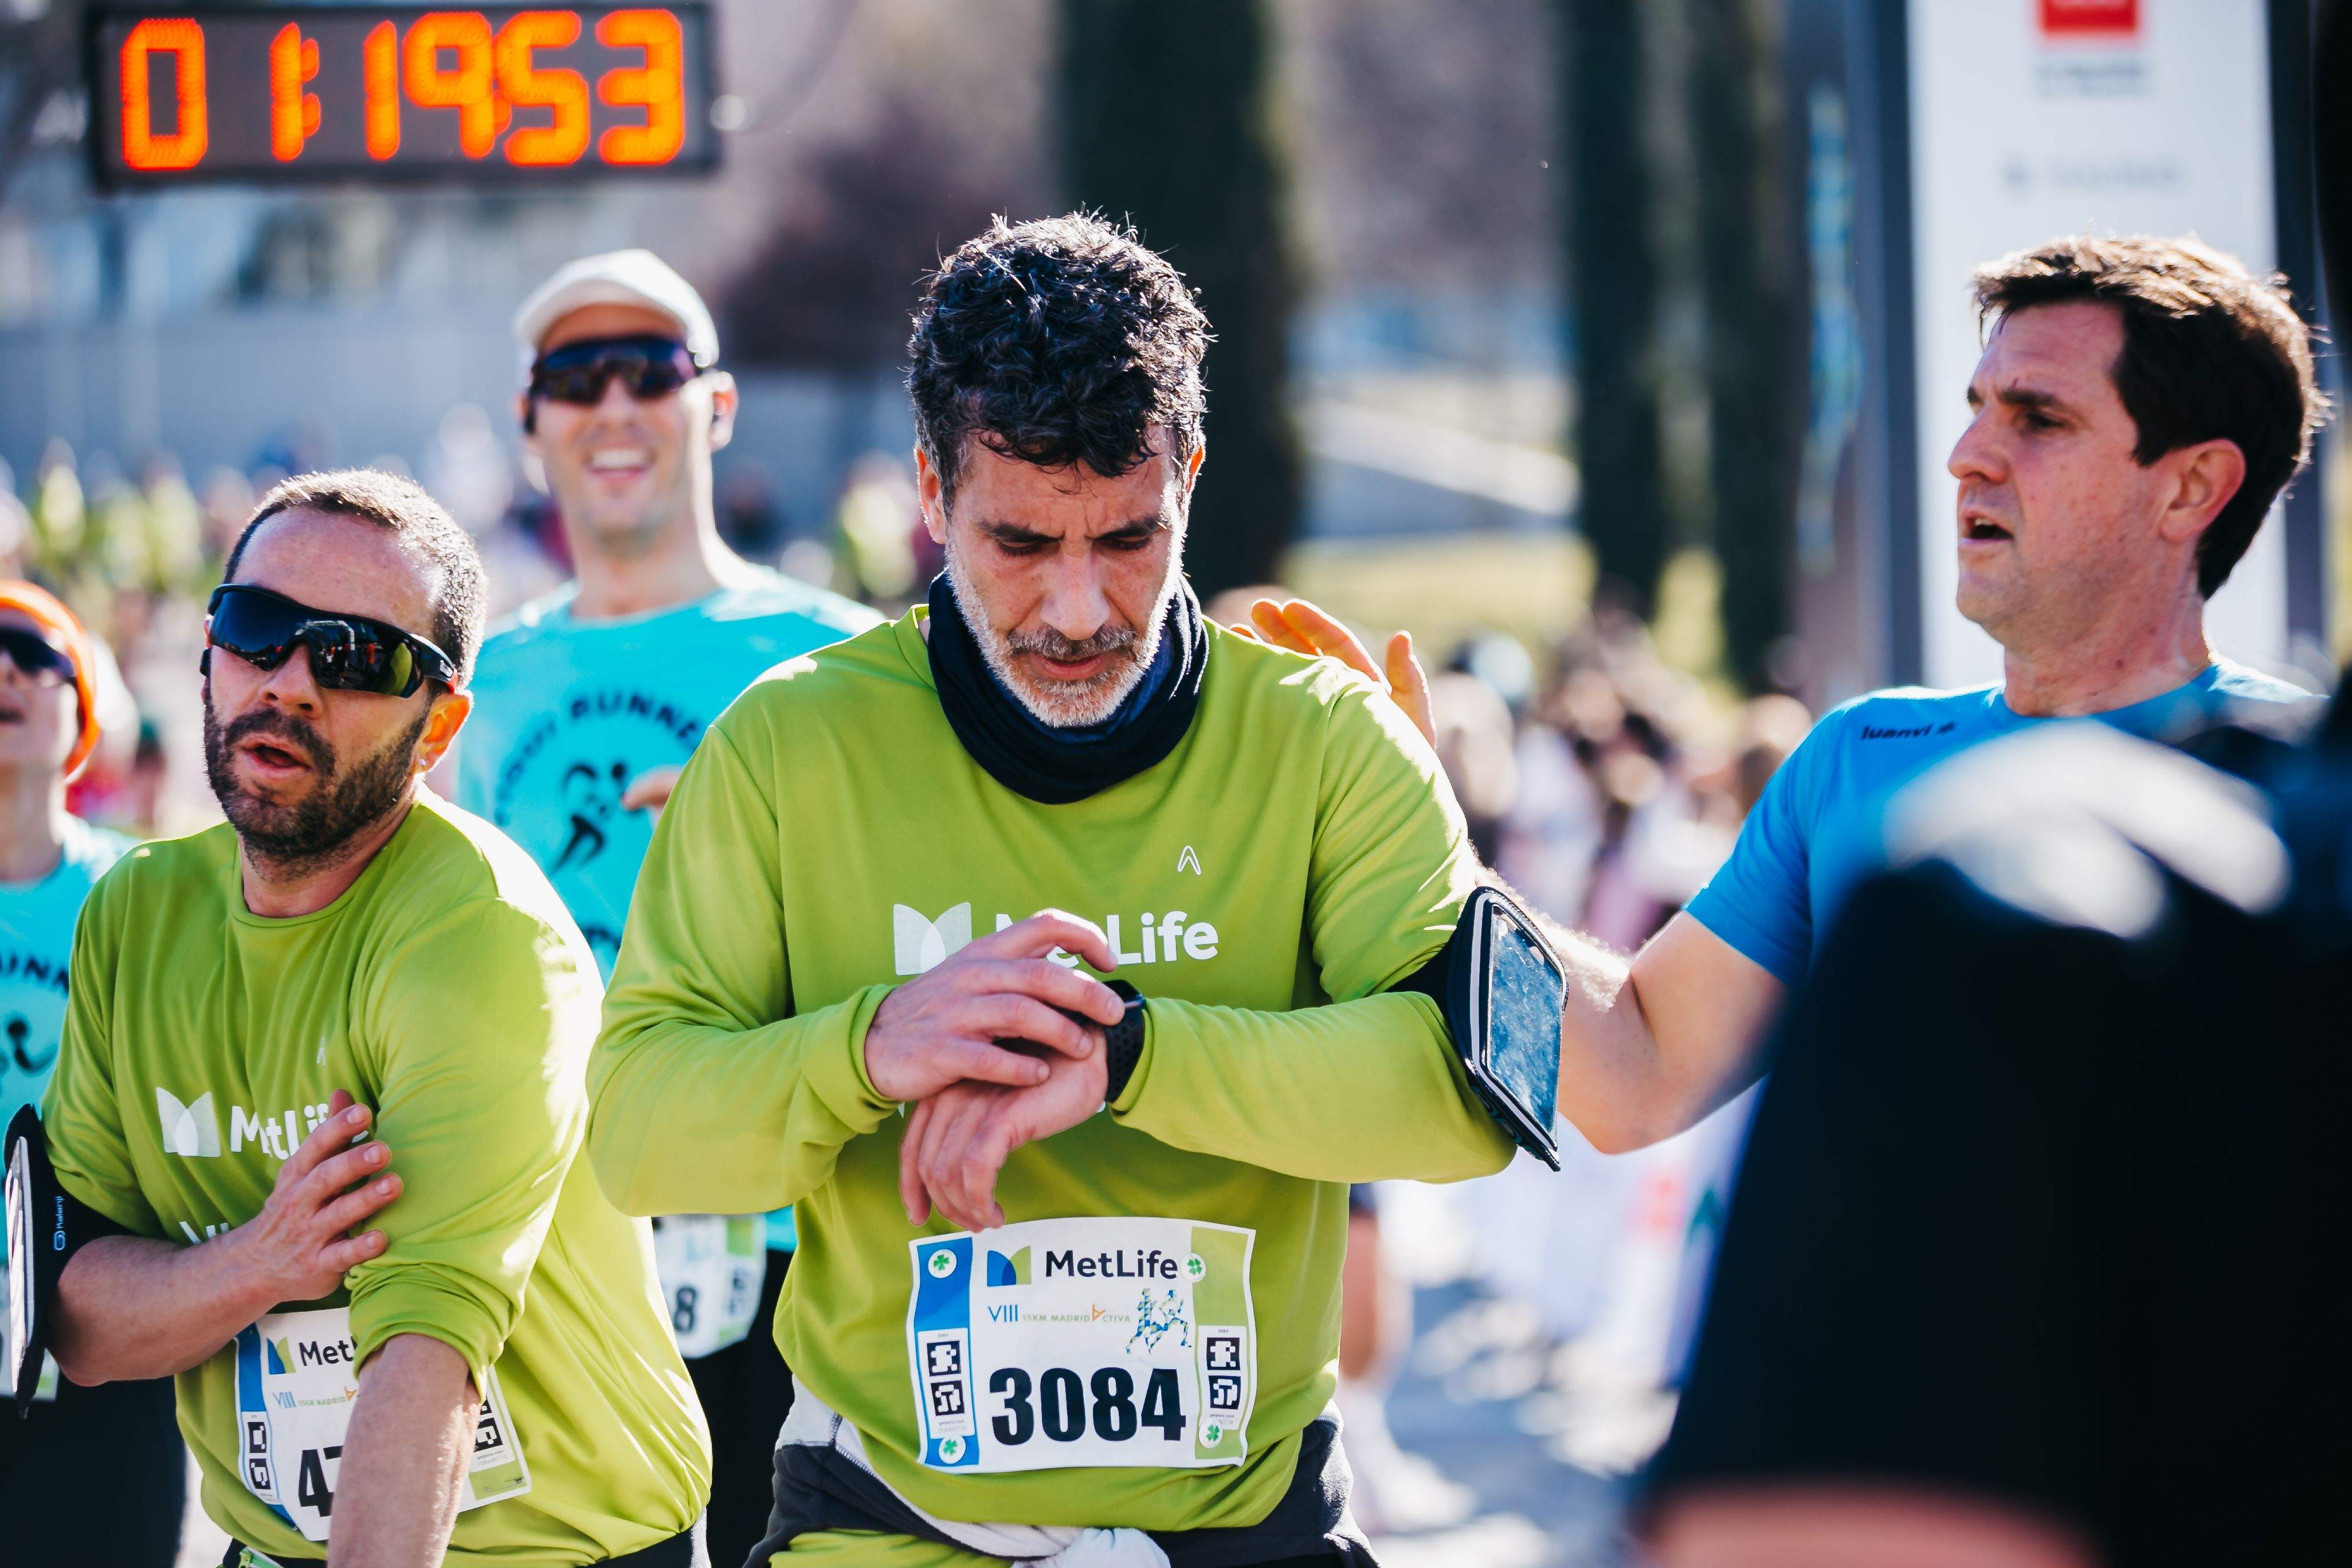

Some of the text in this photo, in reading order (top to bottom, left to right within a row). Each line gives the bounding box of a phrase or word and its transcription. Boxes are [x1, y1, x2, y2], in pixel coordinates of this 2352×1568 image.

[995, 910, 1218, 969] Life
[1046, 1249, 1178, 1279] MetLife
[987, 1304, 1018, 1323] VIII
[1050, 1314, 1089, 1322] MADRID
[989, 1367, 1186, 1446] 3084
